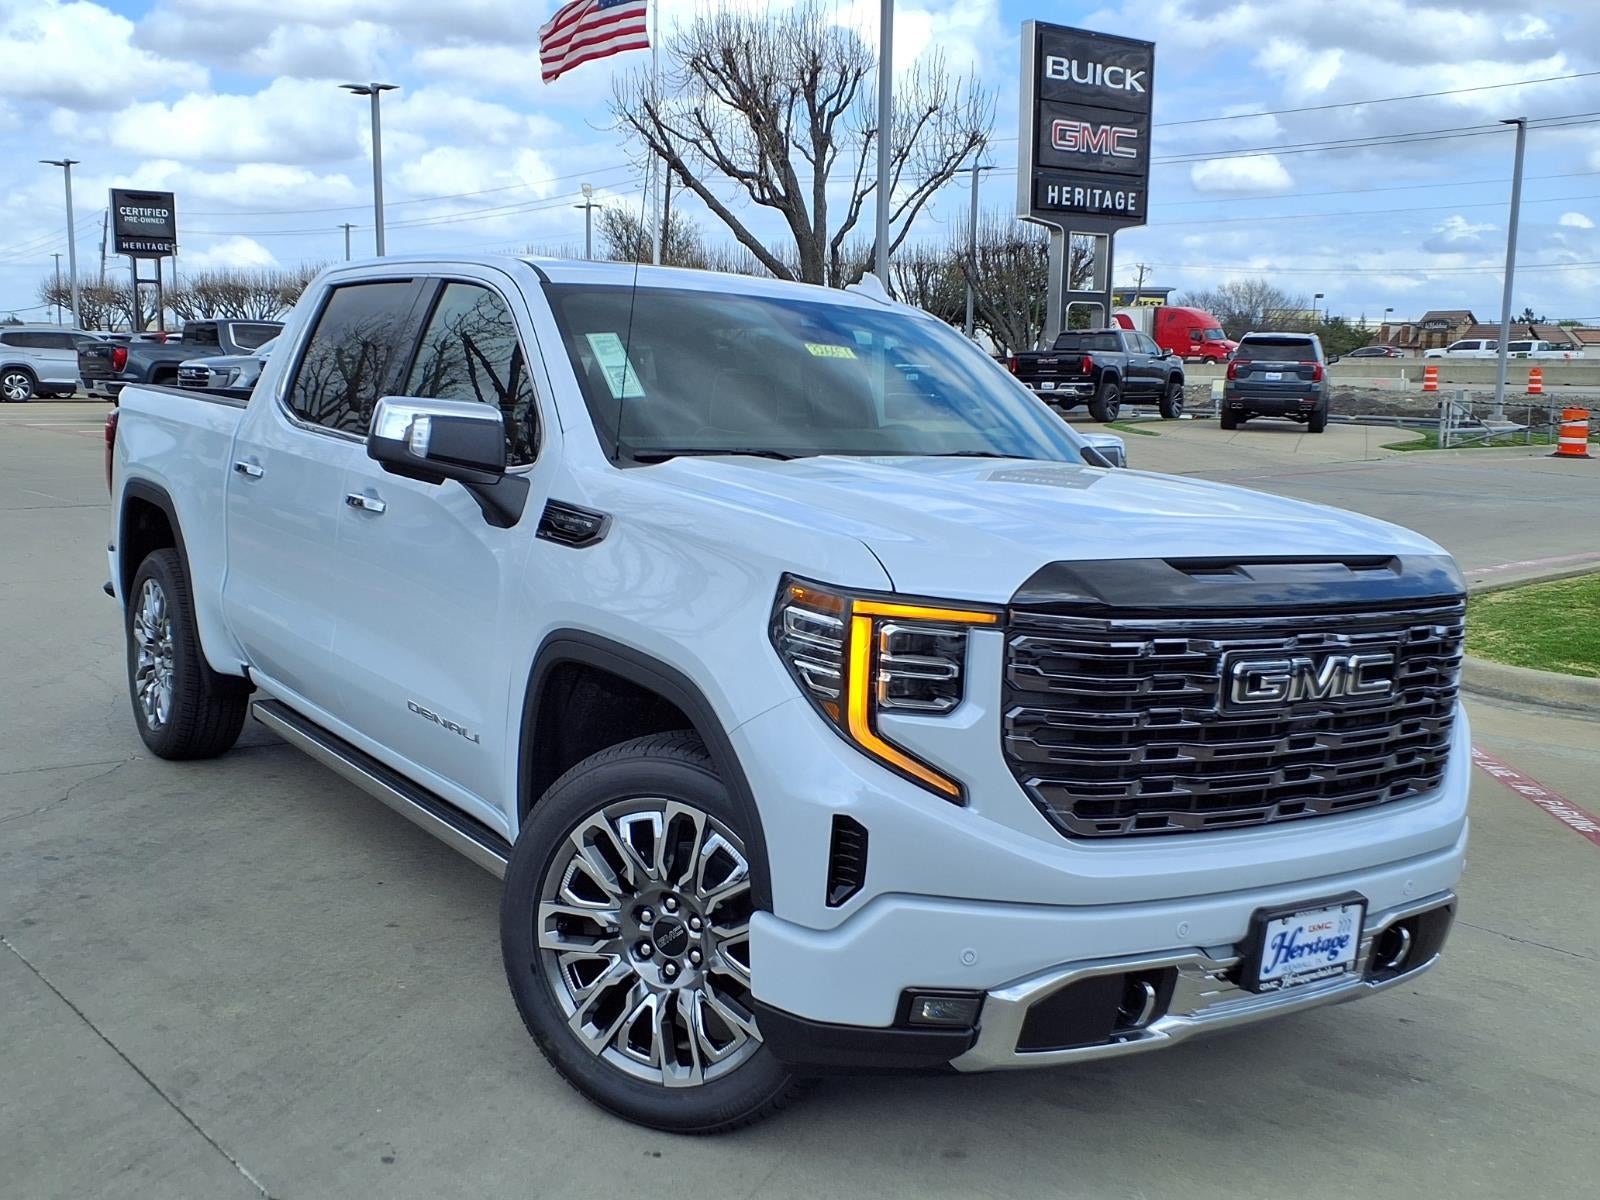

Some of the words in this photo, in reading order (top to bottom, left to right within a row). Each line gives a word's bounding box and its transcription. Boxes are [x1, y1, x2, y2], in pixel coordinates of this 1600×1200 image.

[1046, 55, 1146, 93] BUICK
[1051, 119, 1138, 158] GMC
[119, 206, 169, 217] CERTIFIED
[1047, 185, 1137, 211] HERITAGE
[124, 216, 165, 225] PRE-OWNED
[122, 241, 171, 251] HERITAGE
[1230, 653, 1395, 704] GMC
[407, 698, 480, 745] DENALI
[1307, 920, 1334, 933] GMC
[1263, 926, 1351, 974] Heritage
